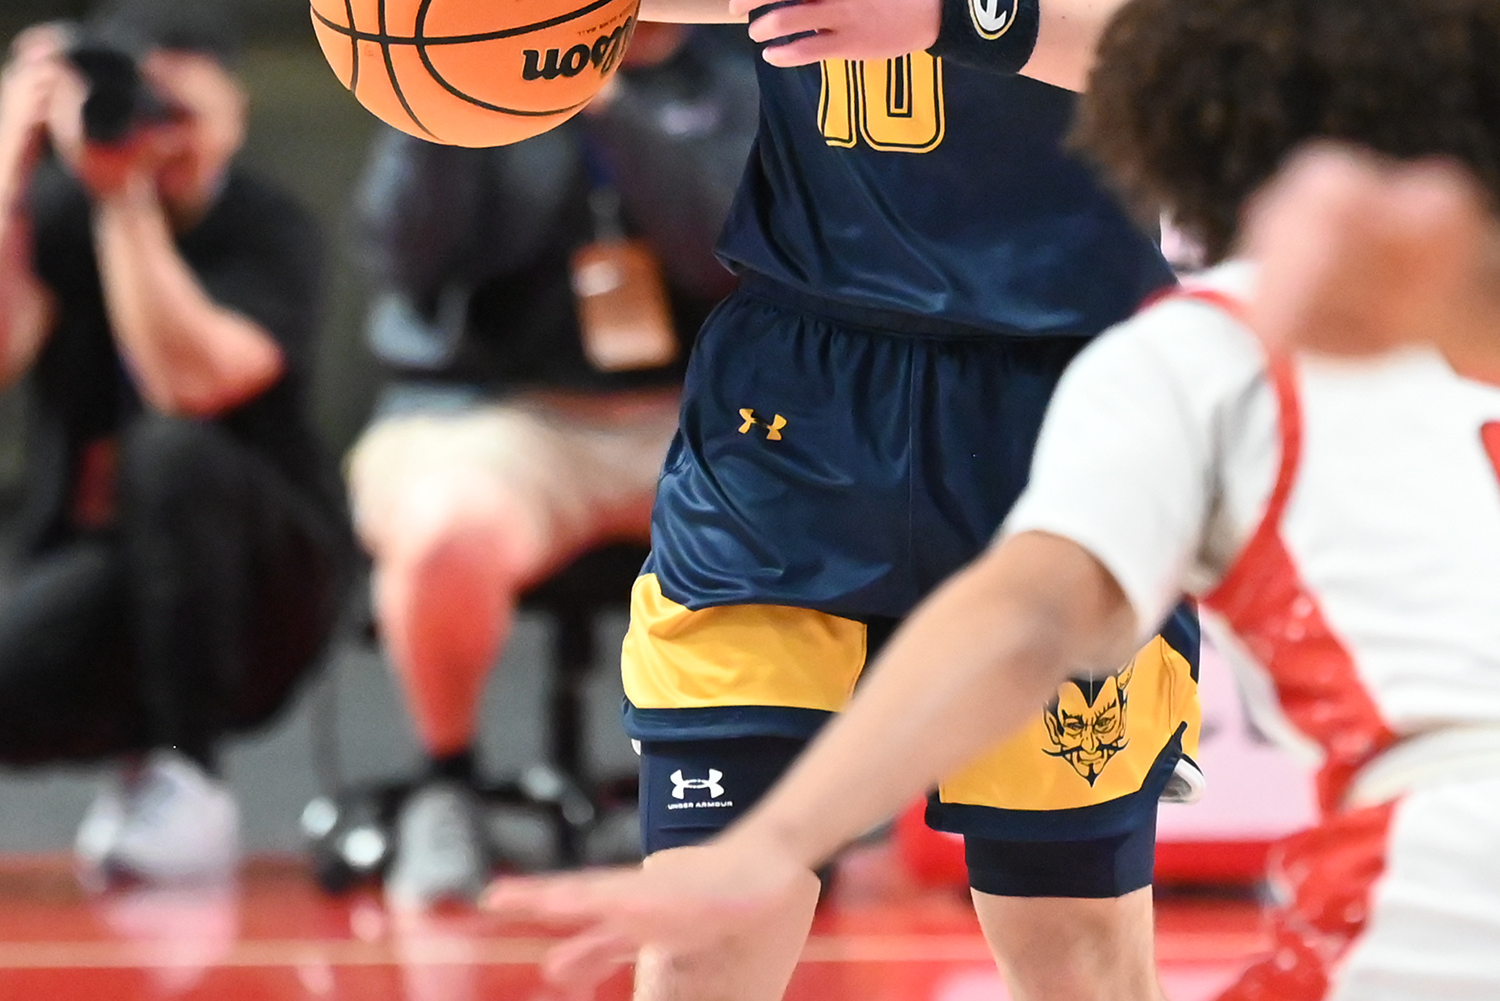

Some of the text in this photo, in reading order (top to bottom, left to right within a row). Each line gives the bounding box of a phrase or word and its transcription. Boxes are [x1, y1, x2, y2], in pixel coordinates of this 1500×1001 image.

[521, 14, 636, 81] lson
[817, 49, 946, 154] 10
[667, 802, 693, 810] UNDER
